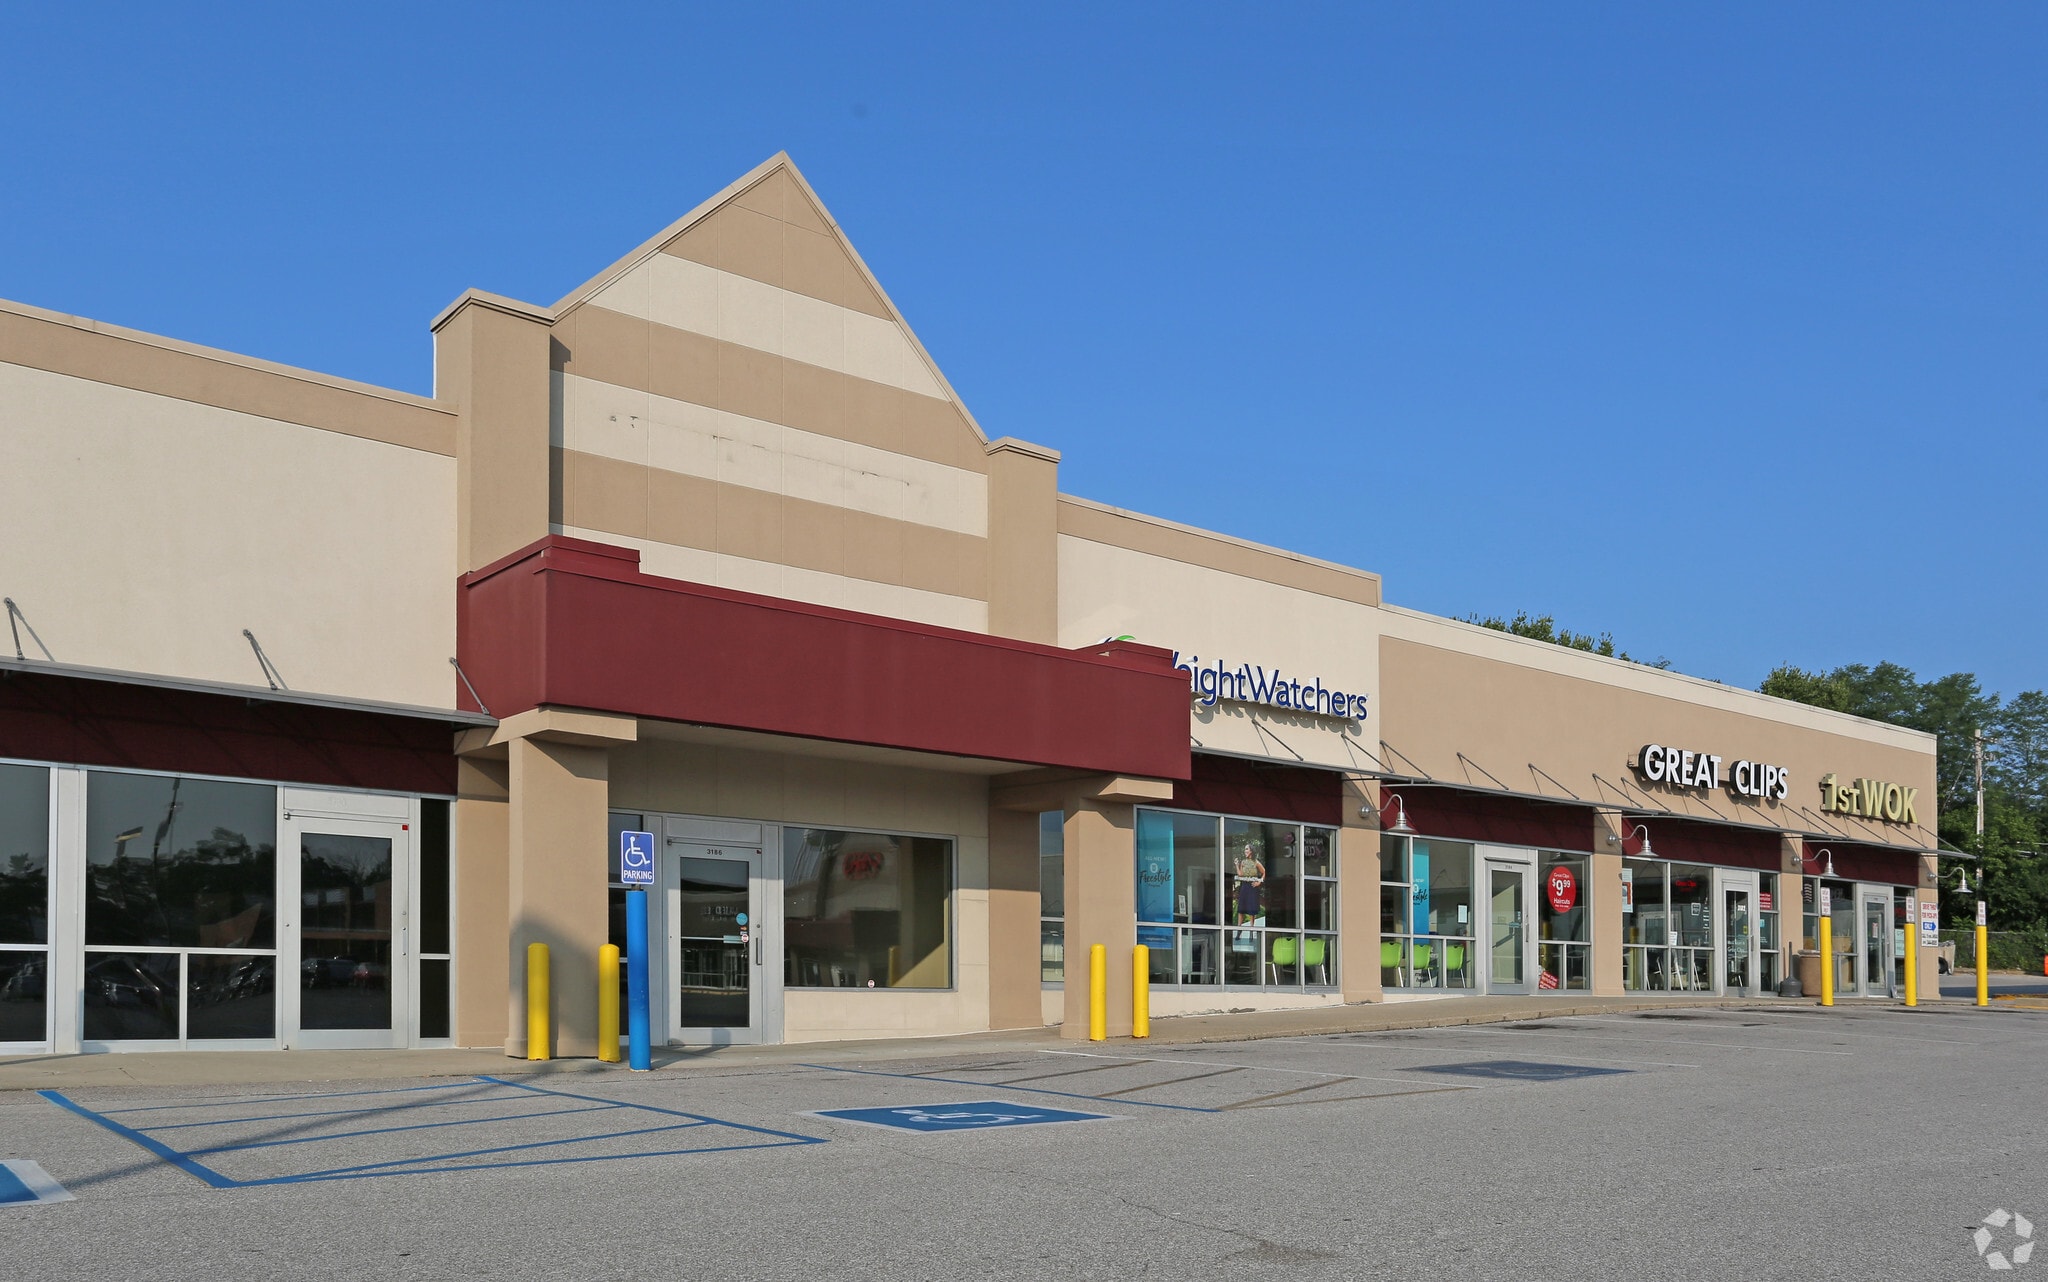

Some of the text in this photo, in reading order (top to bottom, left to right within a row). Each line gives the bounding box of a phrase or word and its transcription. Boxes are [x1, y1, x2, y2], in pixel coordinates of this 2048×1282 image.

[1172, 651, 1367, 720] ightWatchers
[1643, 744, 1789, 800] GREAT CLIPS
[1861, 777, 1918, 824] WOK
[623, 869, 653, 880] PARKING
[1140, 868, 1172, 885] Freestyle
[1553, 897, 1571, 905] Haircuts
